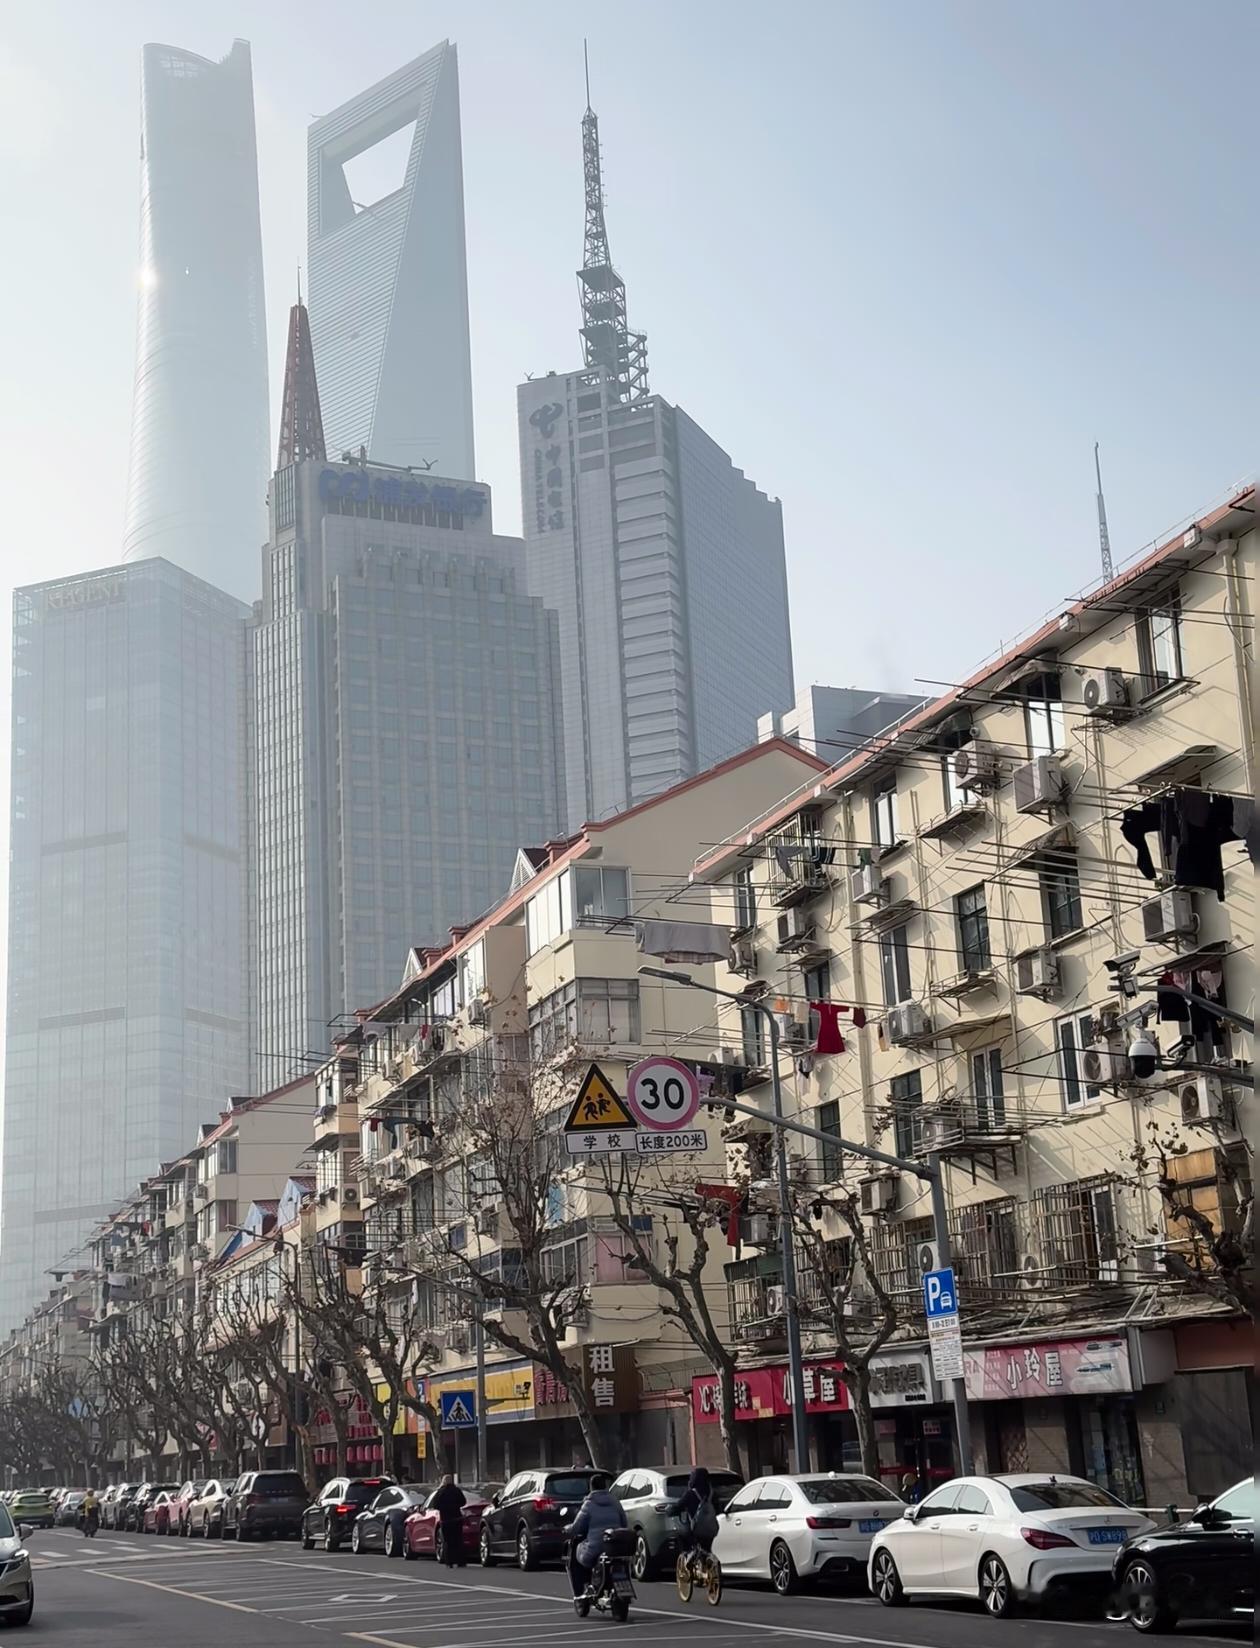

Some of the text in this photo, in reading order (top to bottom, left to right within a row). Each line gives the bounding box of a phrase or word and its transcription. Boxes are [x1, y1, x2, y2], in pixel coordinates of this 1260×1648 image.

[640, 1077, 685, 1110] 30
[583, 1134, 622, 1149] 学校
[639, 1134, 704, 1149] 长度200米
[927, 1276, 941, 1312] P
[588, 1346, 615, 1407] 租售
[1006, 1347, 1063, 1391] 小玲屋
